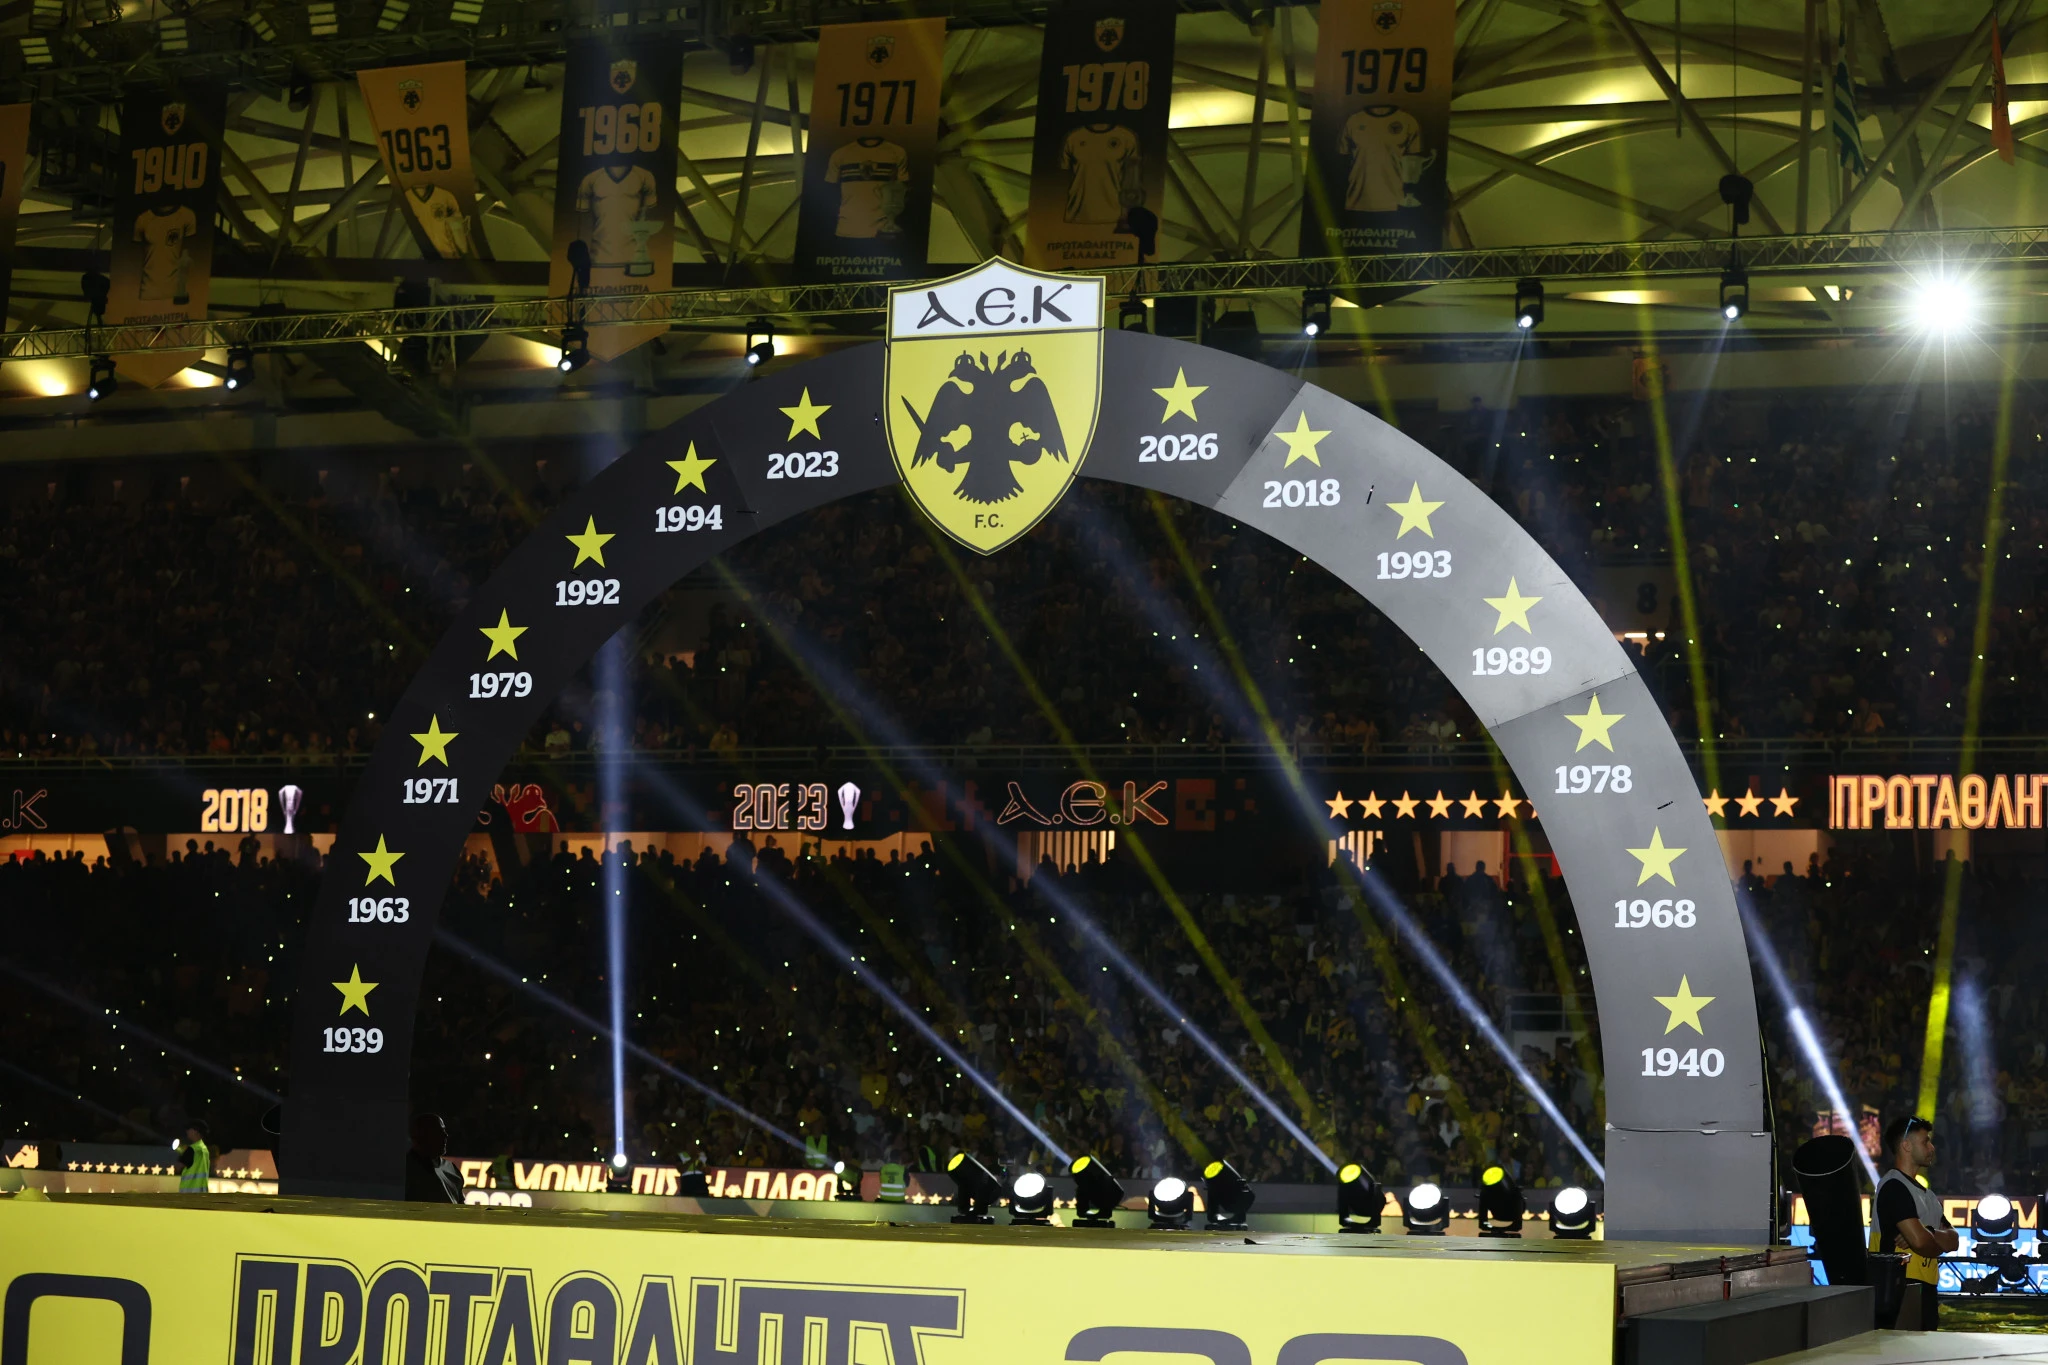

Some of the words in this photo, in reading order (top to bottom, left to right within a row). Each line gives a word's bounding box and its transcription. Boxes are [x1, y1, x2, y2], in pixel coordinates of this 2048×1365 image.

[1341, 47, 1428, 96] 1979
[1062, 61, 1149, 113] 1978
[837, 79, 917, 127] 1971
[578, 101, 662, 156] 1968
[381, 124, 452, 173] 1963
[132, 142, 208, 195] 1940
[1325, 227, 1417, 239] ΠΡΩΤΑΘΛΗΤΡΙΑ
[816, 256, 901, 267] ΠΡΩΤΑΘΛΗΤΡΙΑ
[1138, 432, 1219, 463] 2026
[766, 450, 839, 480] 2023
[1262, 478, 1341, 508] 2018
[655, 504, 723, 533] 1994
[974, 513, 1004, 529] F.C.
[1376, 550, 1452, 580] 1993
[555, 578, 621, 606] 1992
[1637, 582, 1657, 614] 8
[1472, 646, 1552, 676] 1989
[469, 671, 533, 699] 1979
[403, 778, 460, 804] 1971
[1555, 764, 1633, 794] 1978
[201, 788, 269, 832] 2018
[733, 783, 828, 830] 2023
[1829, 773, 2048, 829] ΠΡΩΤΑΘΛΗ
[348, 897, 410, 923] 1963
[1614, 899, 1697, 929] 1968
[323, 1027, 384, 1054] 1939
[1641, 1047, 1725, 1078] 1940
